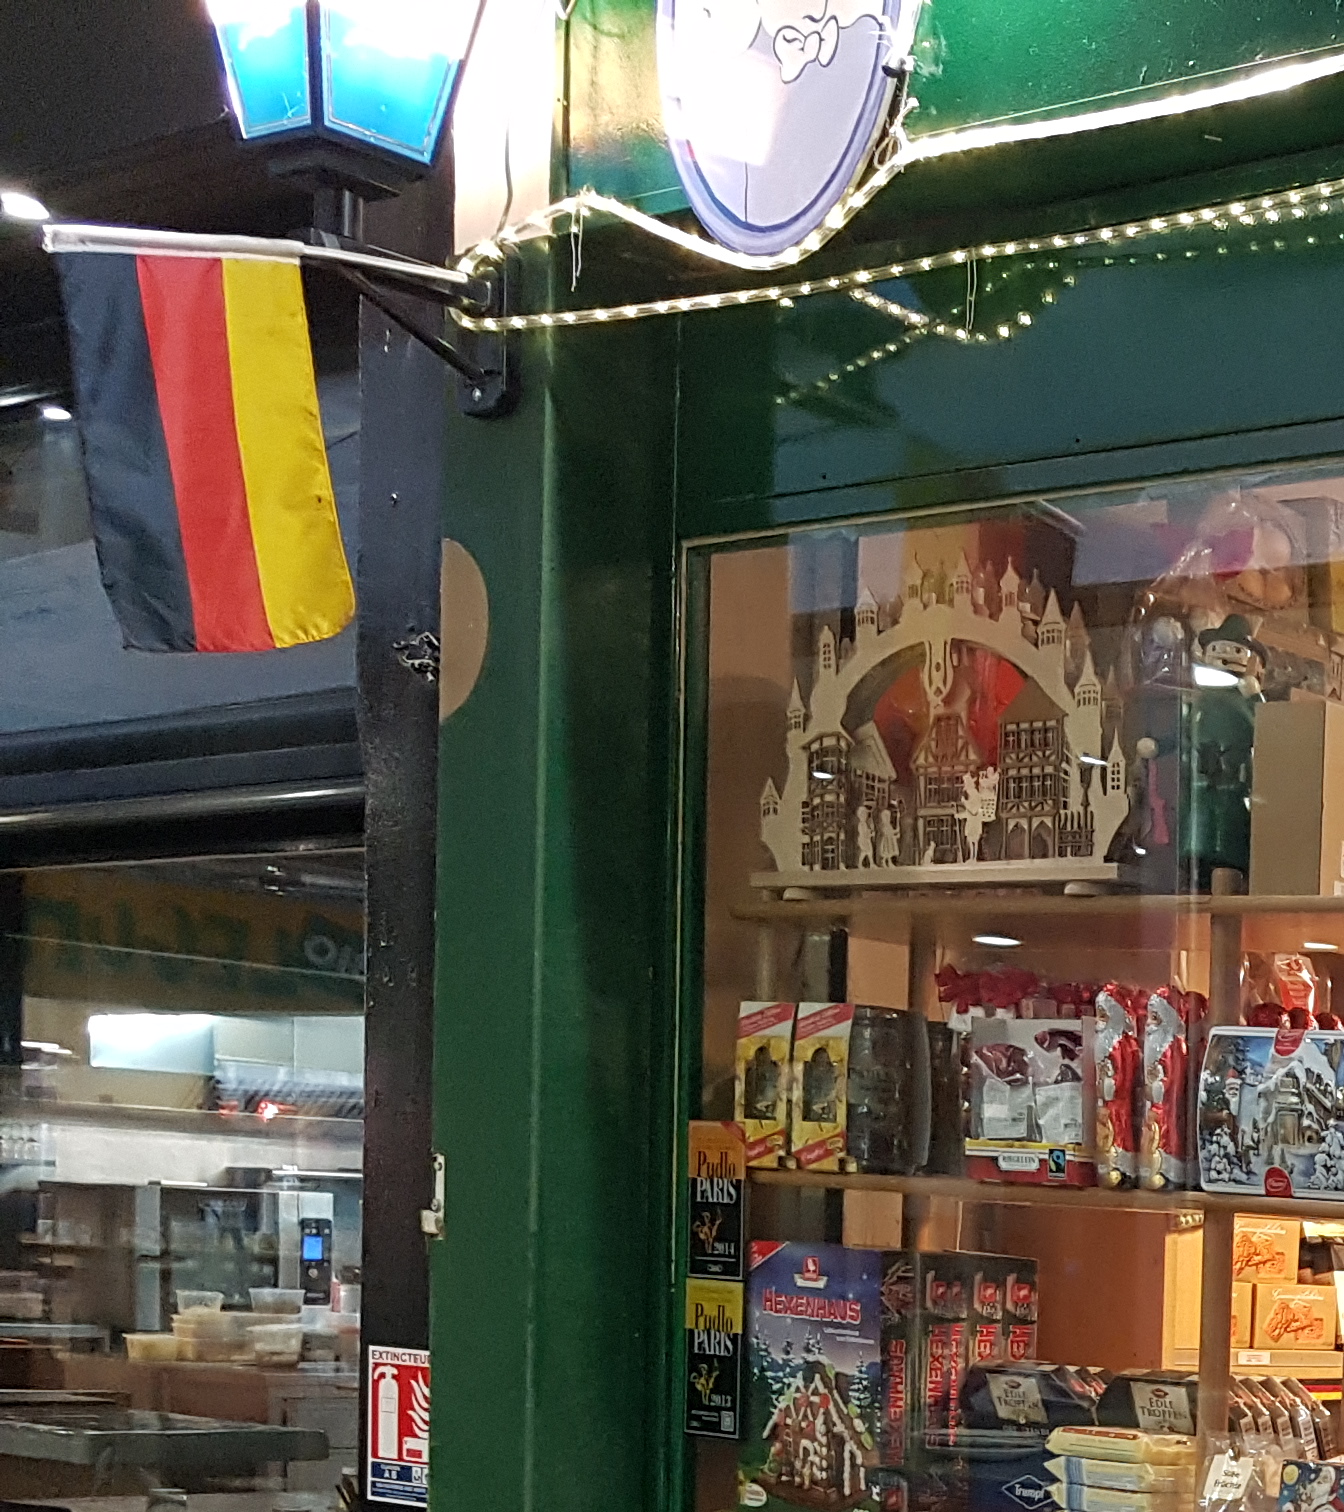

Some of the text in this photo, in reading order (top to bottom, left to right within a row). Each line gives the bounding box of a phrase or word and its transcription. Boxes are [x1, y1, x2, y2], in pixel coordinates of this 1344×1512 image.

[696, 1150, 736, 1179] Pudlo
[695, 1178, 736, 1204] PARIS
[712, 1242, 735, 1255] 2014
[694, 1302, 734, 1333] Pudlo
[762, 1295, 862, 1325] HEXENHAUS
[692, 1331, 734, 1357] PARIS
[709, 1394, 732, 1408] 2013
[1014, 1484, 1045, 1501] Trumpf
